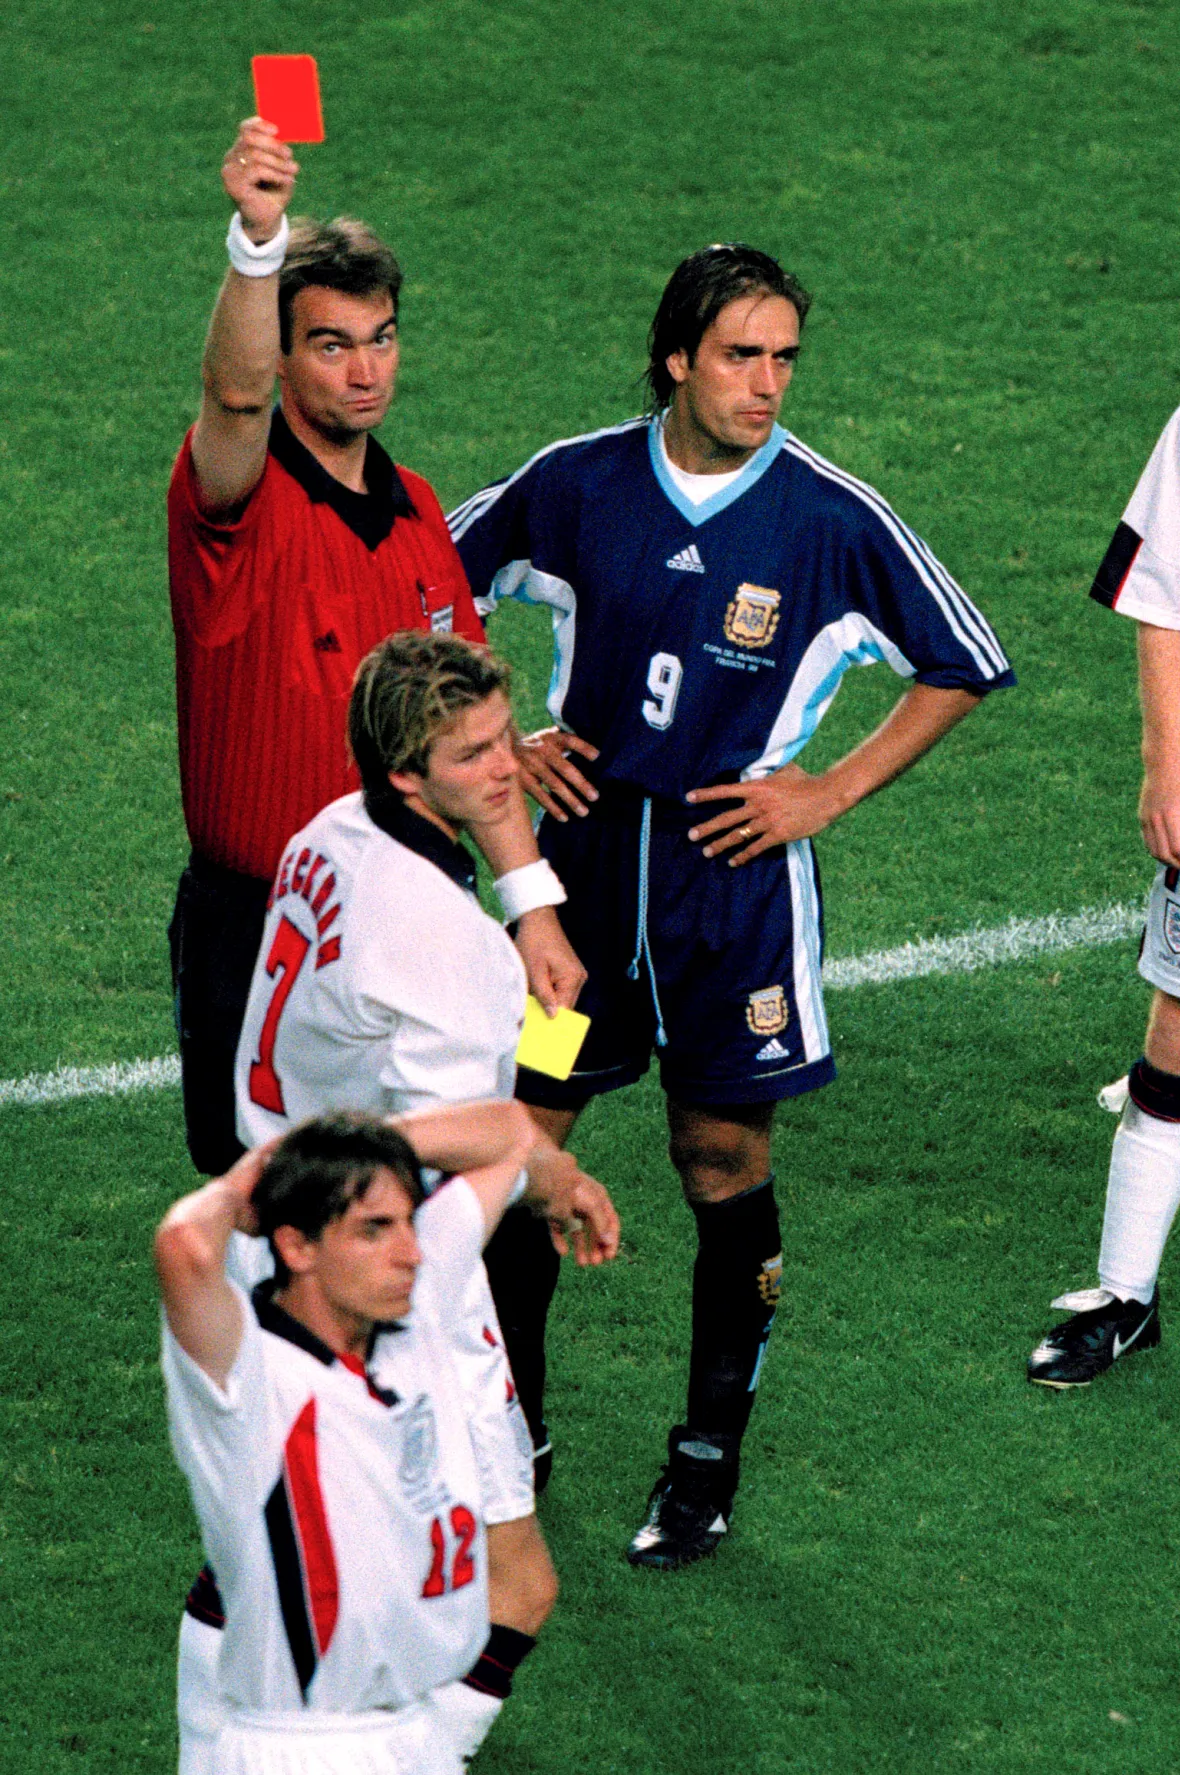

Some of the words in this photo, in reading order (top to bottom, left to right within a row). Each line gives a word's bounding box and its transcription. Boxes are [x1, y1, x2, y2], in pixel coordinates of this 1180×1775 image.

[642, 651, 684, 731] 9
[249, 912, 312, 1117] 7
[420, 1503, 477, 1599] 12
